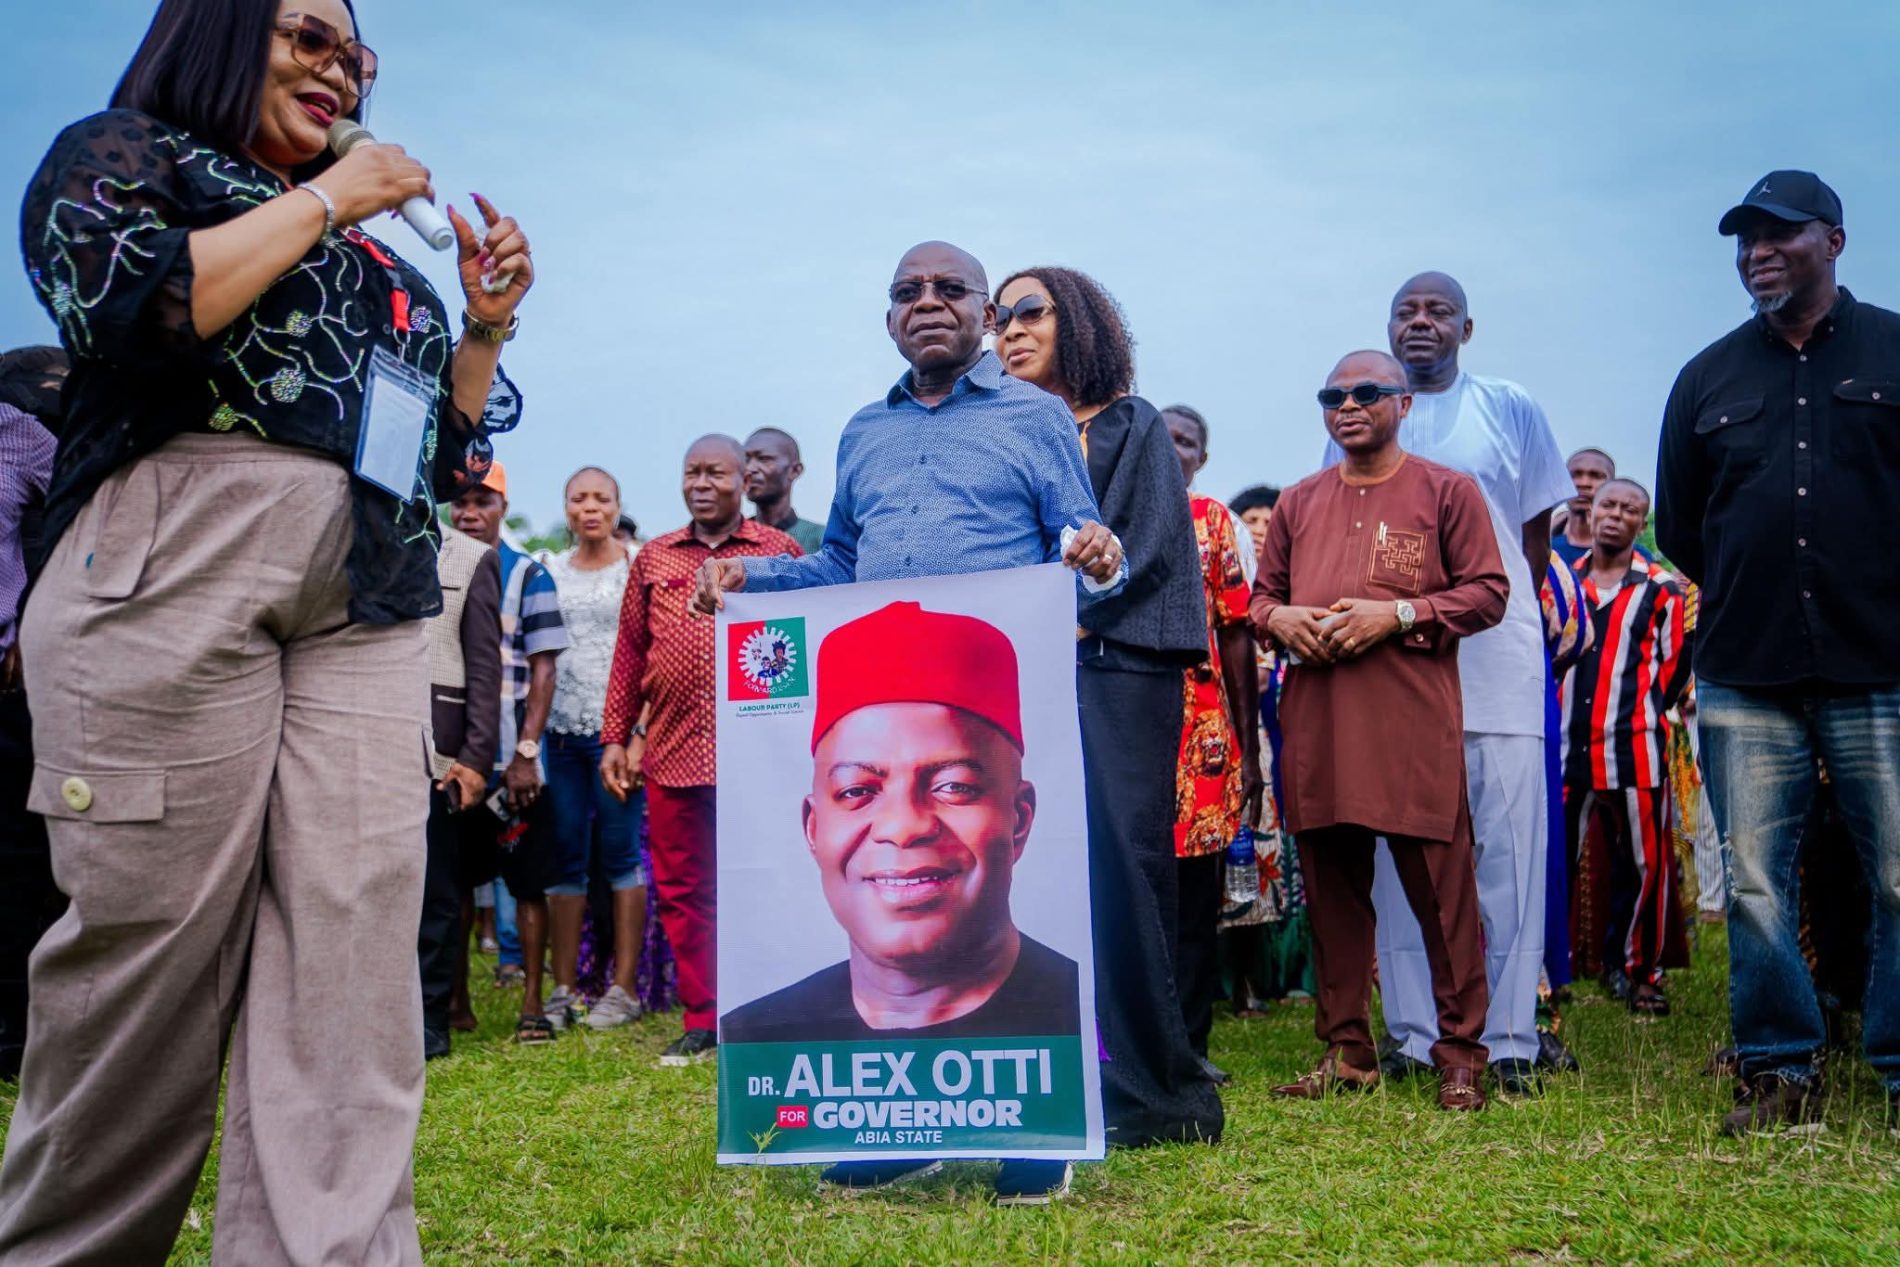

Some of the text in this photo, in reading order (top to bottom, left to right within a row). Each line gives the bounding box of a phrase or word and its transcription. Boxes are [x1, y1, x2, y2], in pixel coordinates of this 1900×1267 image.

[787, 702, 800, 710] (LP)
[748, 1049, 1052, 1098] DR. ALEX OTTI
[780, 1099, 1023, 1129] FOR GOVERNOR
[855, 1130, 943, 1144] ABIA STATE
